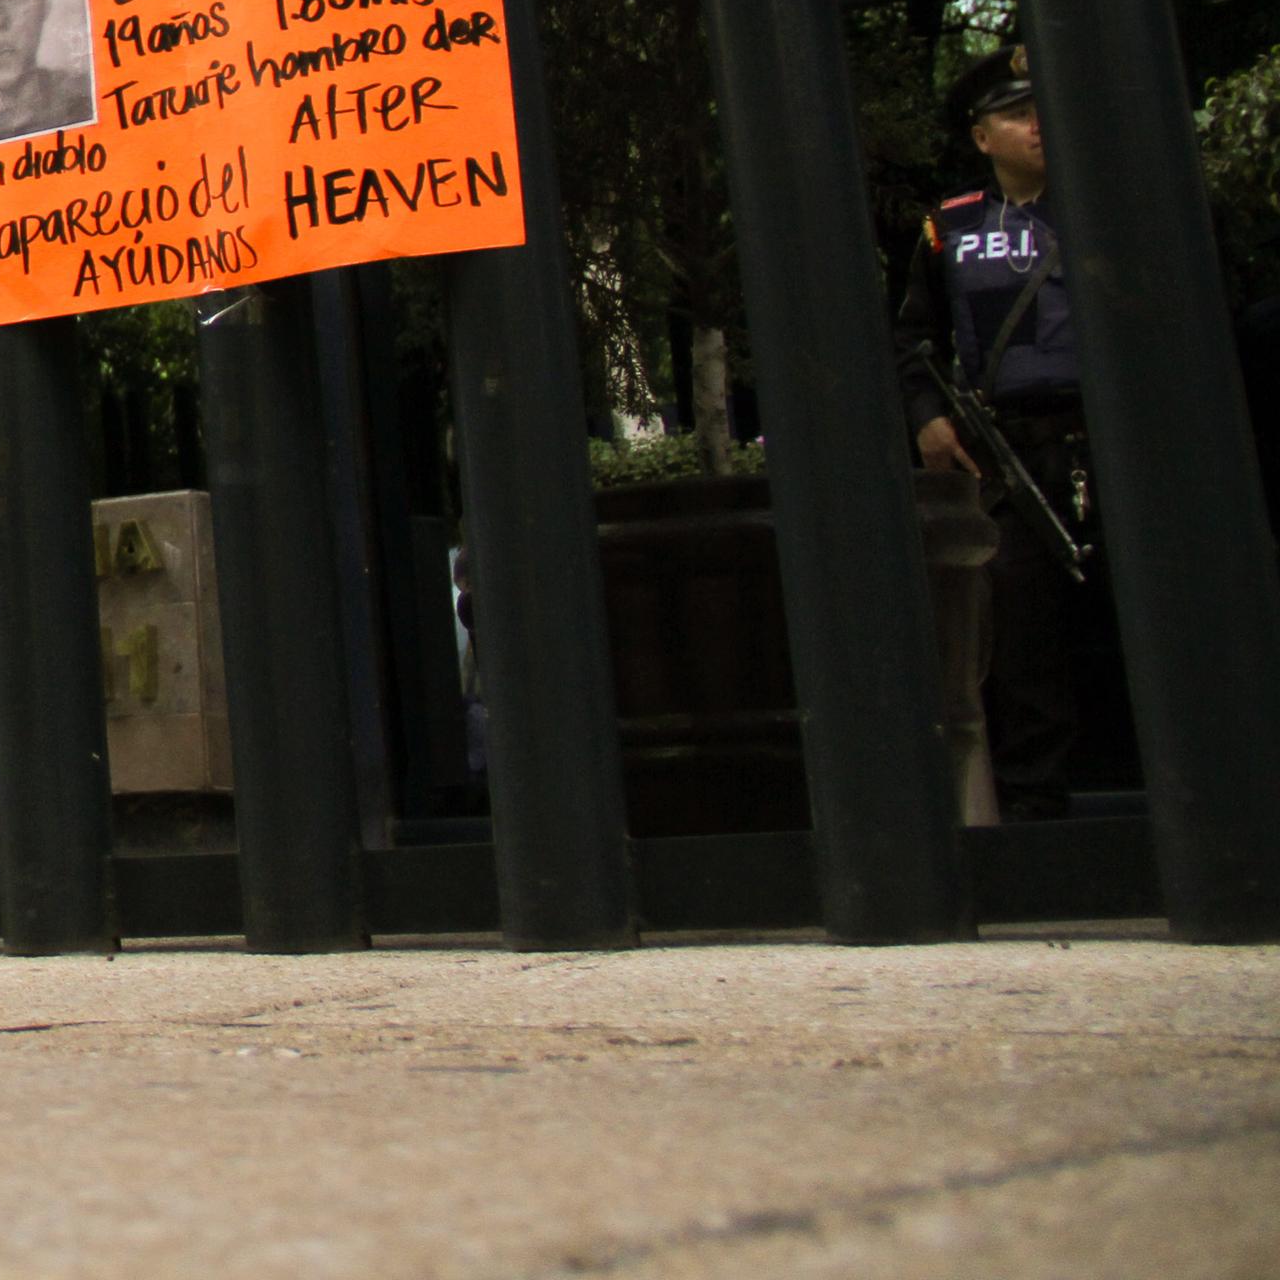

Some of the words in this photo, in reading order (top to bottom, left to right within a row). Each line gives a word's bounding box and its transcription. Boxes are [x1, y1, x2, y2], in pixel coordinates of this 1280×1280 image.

[104, 22, 145, 68] 19
[148, 4, 229, 55] años
[9, 131, 106, 185] diablo
[189, 146, 248, 218] del
[285, 152, 508, 240] HEAVEN
[72, 225, 259, 298] AYÚDANOS
